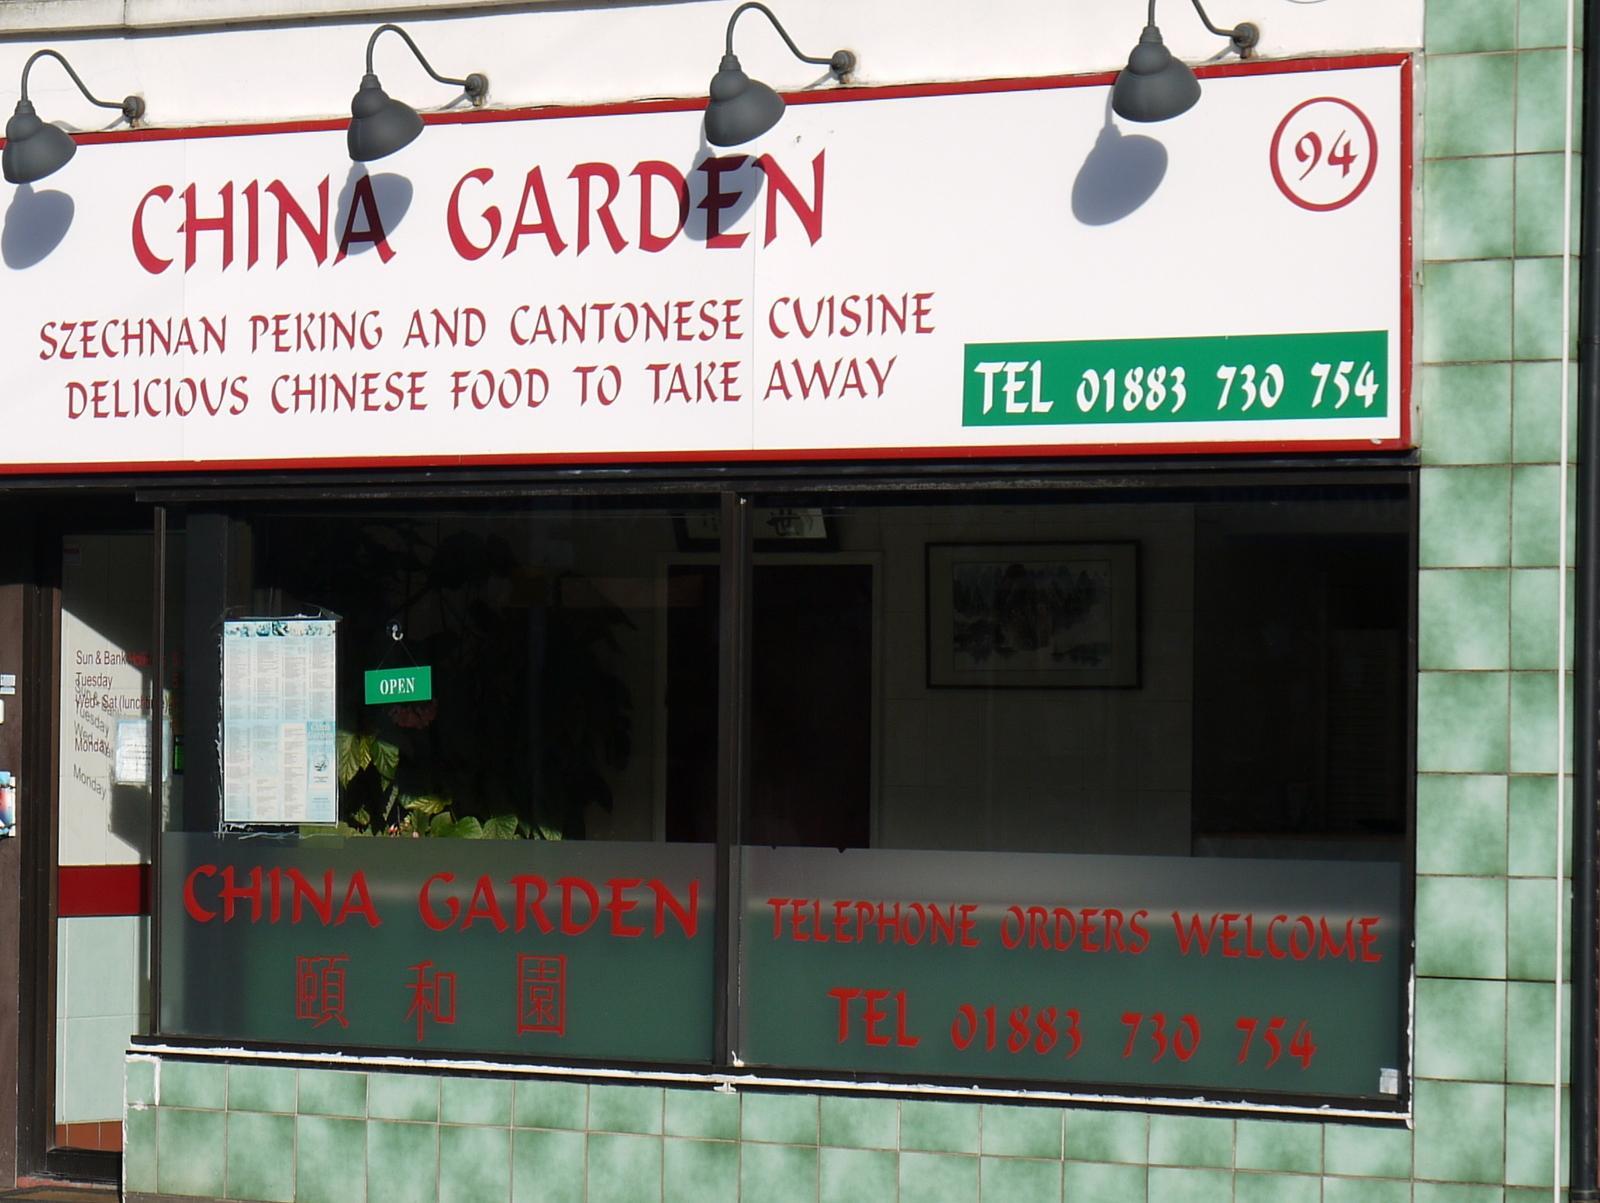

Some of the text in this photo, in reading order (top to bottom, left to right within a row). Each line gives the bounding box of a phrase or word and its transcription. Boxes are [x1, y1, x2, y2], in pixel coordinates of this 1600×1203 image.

[1294, 129, 1358, 181] 94
[132, 151, 826, 275] CHINA GARDEN
[39, 292, 935, 360] SZECHNAN PEKING AND CANTONESE CUISINE
[66, 355, 897, 420] DELICIOUS CHINESE FOOD TO TAKE AWAY
[974, 360, 1380, 415] TEL 01883 730 754
[75, 672, 113, 690] Tuesday
[76, 650, 93, 665] Sun
[95, 650, 102, 665] &
[104, 650, 127, 666] Bank
[379, 677, 416, 696] OPEN
[183, 864, 700, 939] CHINA GARDEN
[767, 897, 1382, 963] TELEPHONE ORDERS WELCOME
[827, 987, 1317, 1068] TEL 01883 730 754
